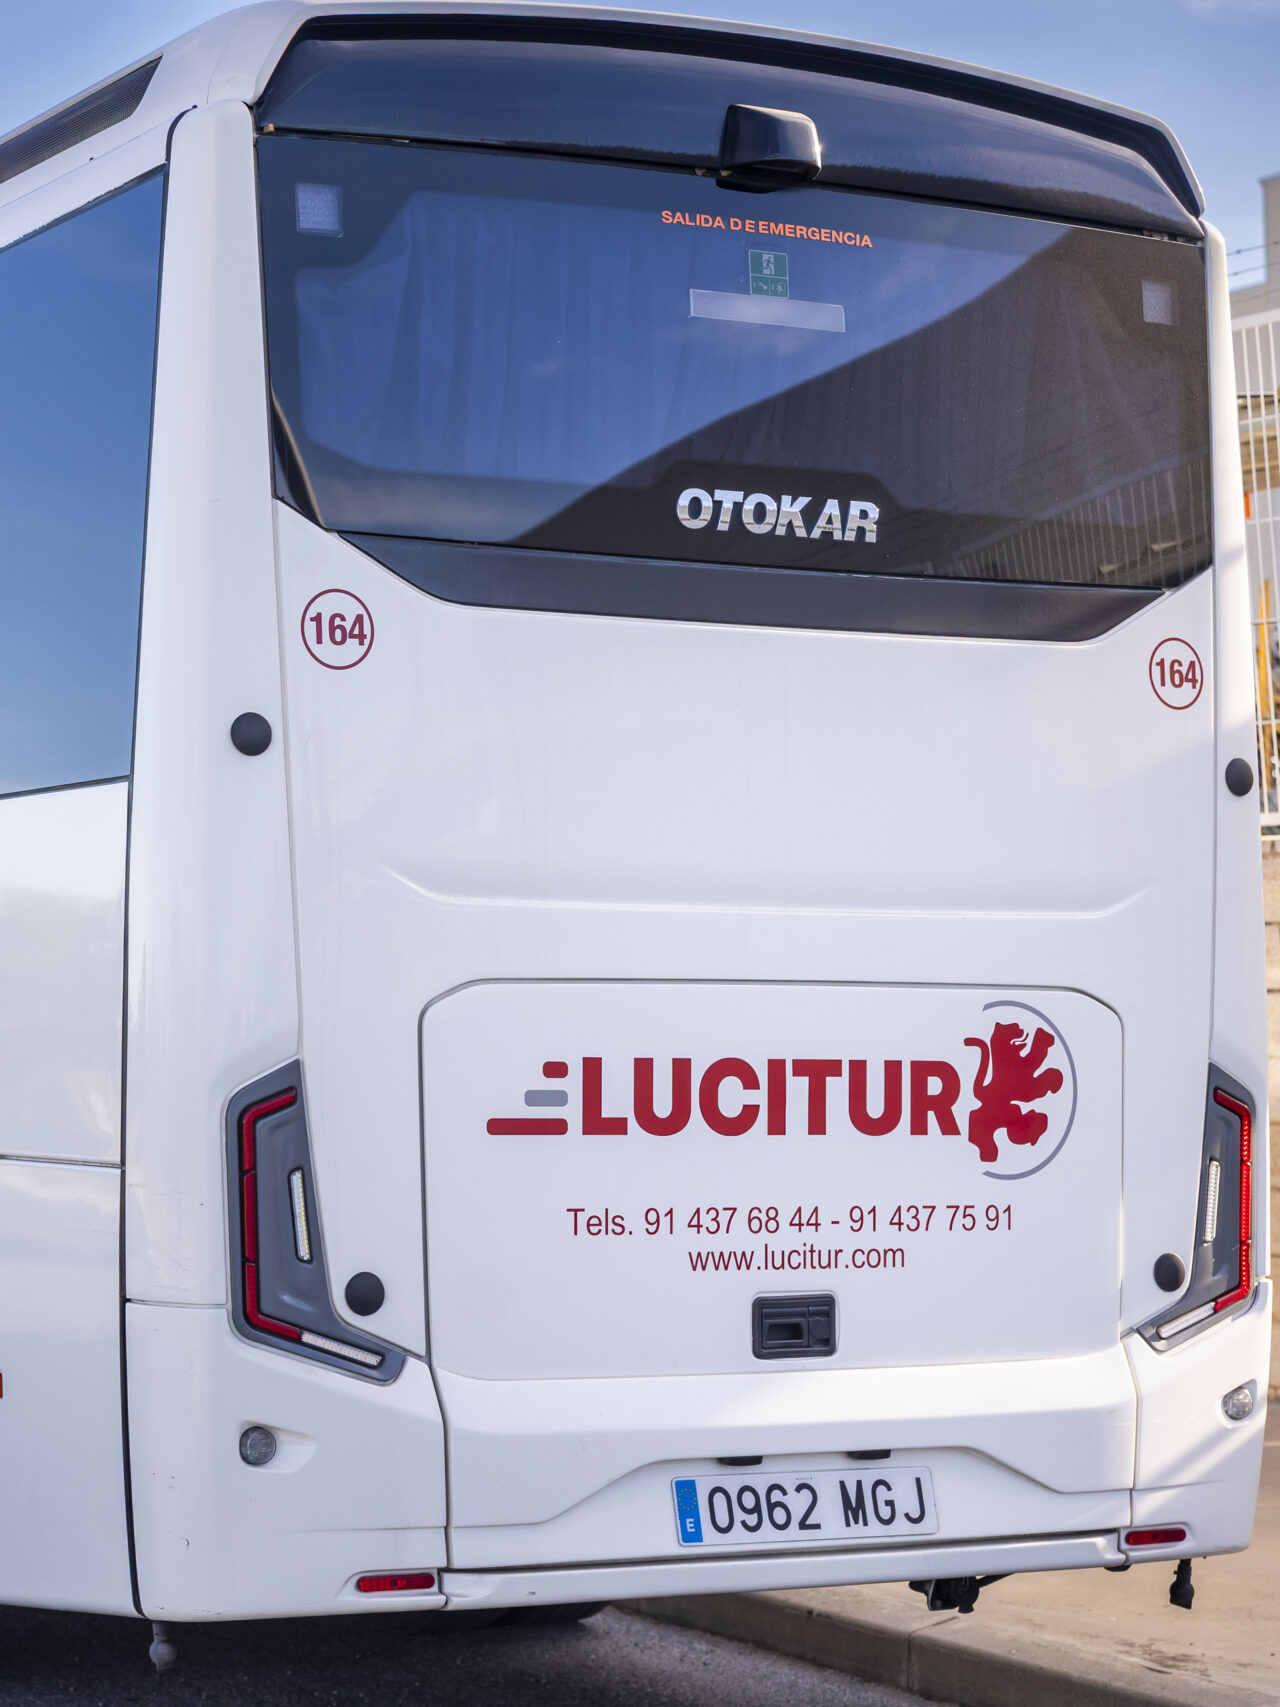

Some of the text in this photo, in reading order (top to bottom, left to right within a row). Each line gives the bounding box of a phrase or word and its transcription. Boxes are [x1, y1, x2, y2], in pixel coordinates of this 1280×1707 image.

[661, 210, 725, 229] SALIDA
[758, 221, 873, 248] EMERGENCIA
[676, 487, 880, 543] OTOKAR
[309, 612, 368, 646] 164
[1155, 658, 1199, 690] 164
[581, 1056, 962, 1137] LUCITUR
[566, 1207, 633, 1236] Tels.
[644, 1207, 674, 1235] 91
[687, 1206, 738, 1234] 437
[747, 1206, 780, 1234] 68
[789, 1205, 822, 1233] 44
[849, 1205, 877, 1232] 91
[889, 1204, 936, 1232] 437
[946, 1204, 977, 1231] 75
[985, 1204, 1012, 1231] 91
[688, 1242, 905, 1272] www.lucitur.com
[686, 1476, 926, 1535] E 0962 MGJ
